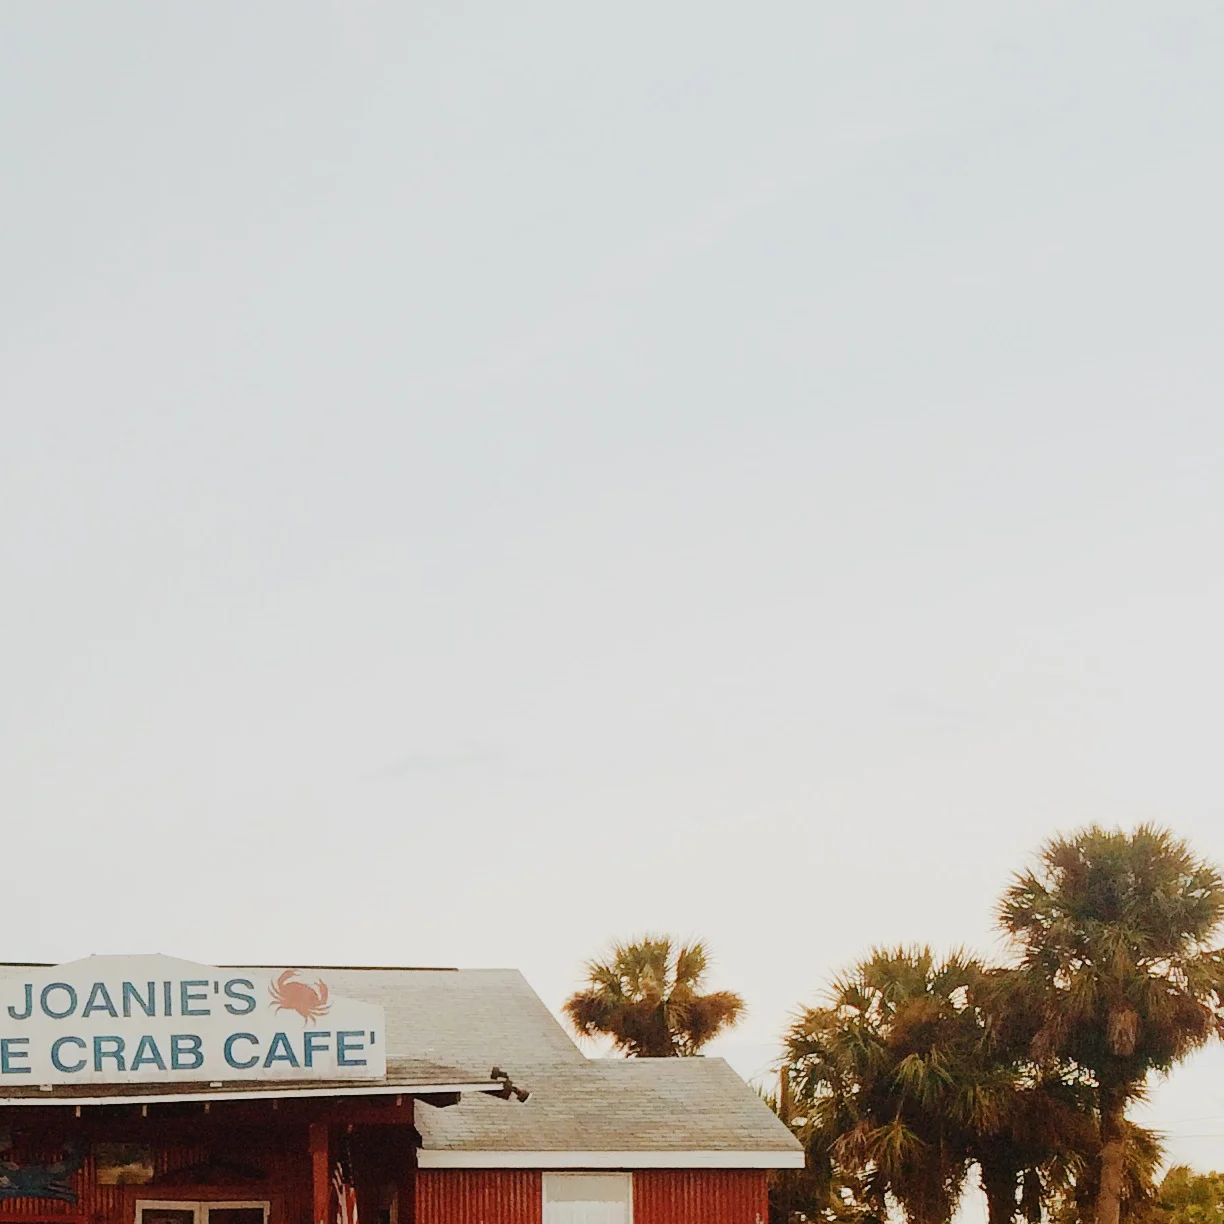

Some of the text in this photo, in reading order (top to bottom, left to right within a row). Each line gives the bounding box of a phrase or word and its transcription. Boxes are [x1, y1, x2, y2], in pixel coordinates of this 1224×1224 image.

[7, 978, 257, 1020] JOANIE'S
[50, 1034, 205, 1074] CRAB
[223, 1030, 376, 1070] CAFE'
